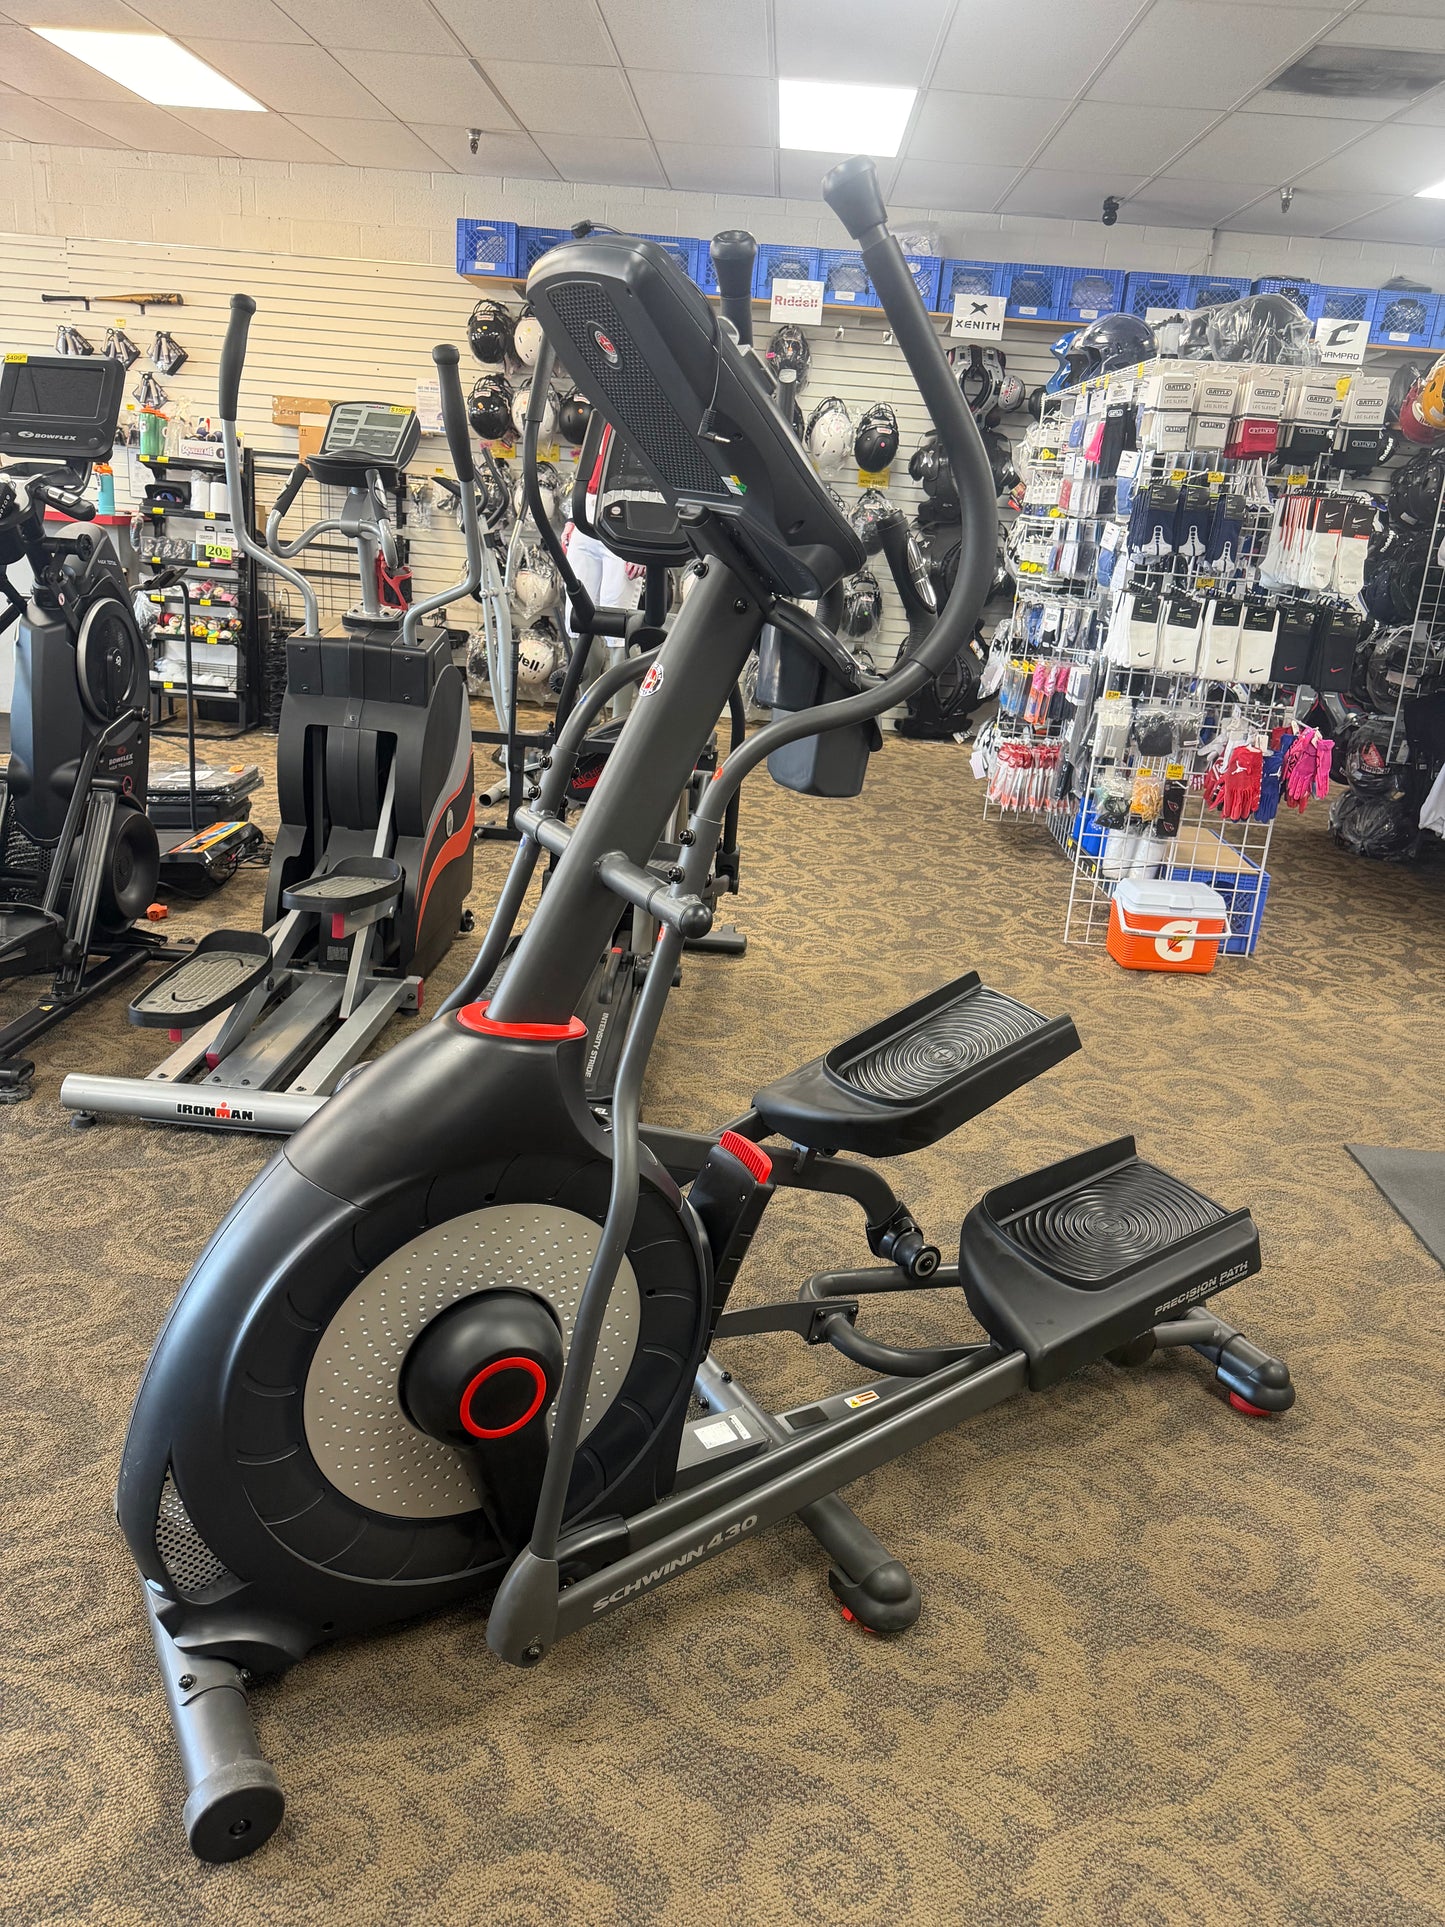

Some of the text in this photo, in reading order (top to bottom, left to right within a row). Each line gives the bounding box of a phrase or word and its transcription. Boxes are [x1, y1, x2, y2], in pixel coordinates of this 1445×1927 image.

[774, 295, 818, 308] Riddell
[955, 319, 1001, 331] XENITH
[1321, 351, 1360, 360] HAMPRO
[34, 433, 77, 441] BOWFLEX
[1379, 437, 1394, 462] Riddell
[109, 753, 133, 765] BOWFLEX
[1154, 920, 1199, 962] G
[585, 1012, 609, 1078] INTENSITY STRIDE
[177, 1101, 253, 1121] IRONMAN
[1219, 1270, 1249, 1287] Technology
[1154, 1260, 1248, 1316] PRECISION PATH
[592, 1515, 758, 1613] SCHWINN 430
